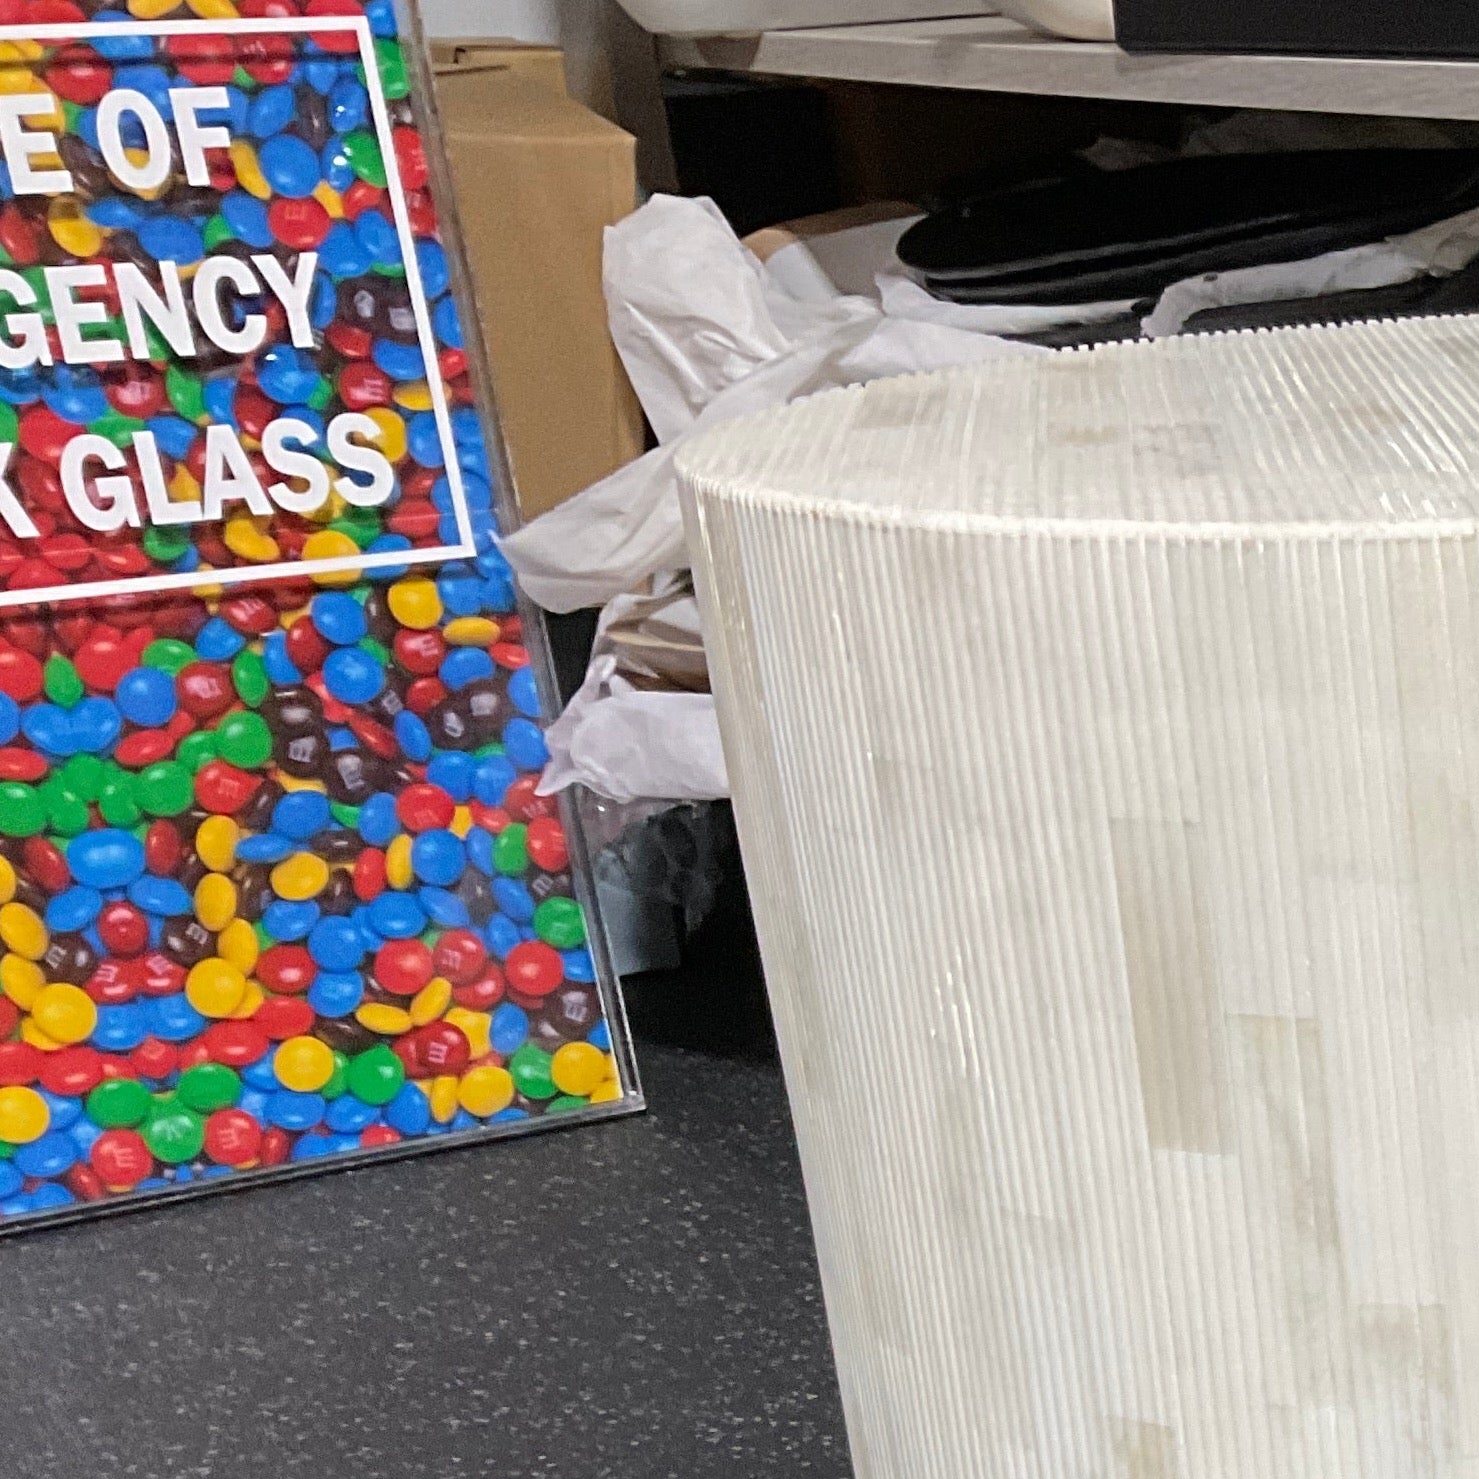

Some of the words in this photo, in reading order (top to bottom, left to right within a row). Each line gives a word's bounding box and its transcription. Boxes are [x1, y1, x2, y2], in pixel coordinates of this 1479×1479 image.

[0, 93, 74, 195] E
[96, 86, 231, 189] OF
[0, 252, 319, 369] GENCY
[60, 412, 395, 532] GLASS
